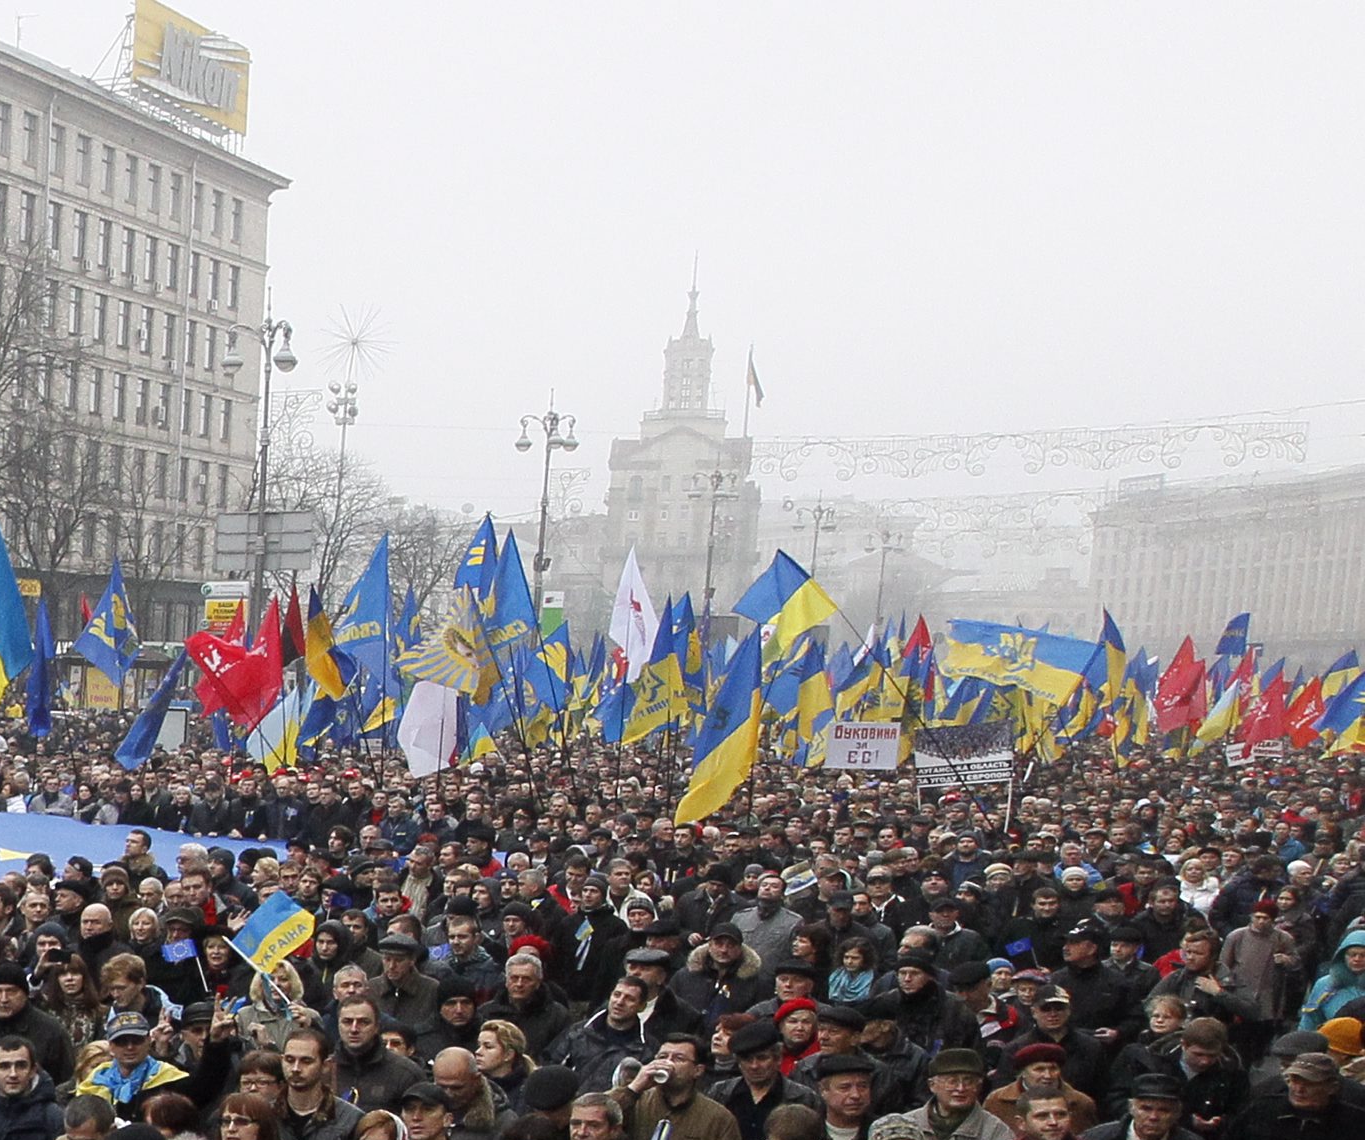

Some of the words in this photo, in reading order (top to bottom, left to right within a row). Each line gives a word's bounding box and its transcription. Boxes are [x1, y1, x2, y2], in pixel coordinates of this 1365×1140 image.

[160, 22, 239, 112] Nikon
[834, 724, 897, 740] БУКОВИНА
[855, 742, 868, 750] ЗА
[969, 761, 1010, 772] ОБЛАСТЬ
[930, 774, 959, 784] УГОДУ
[965, 771, 1011, 782] ЄВРОПОЮ
[257, 923, 308, 968] УКРАЇНА
